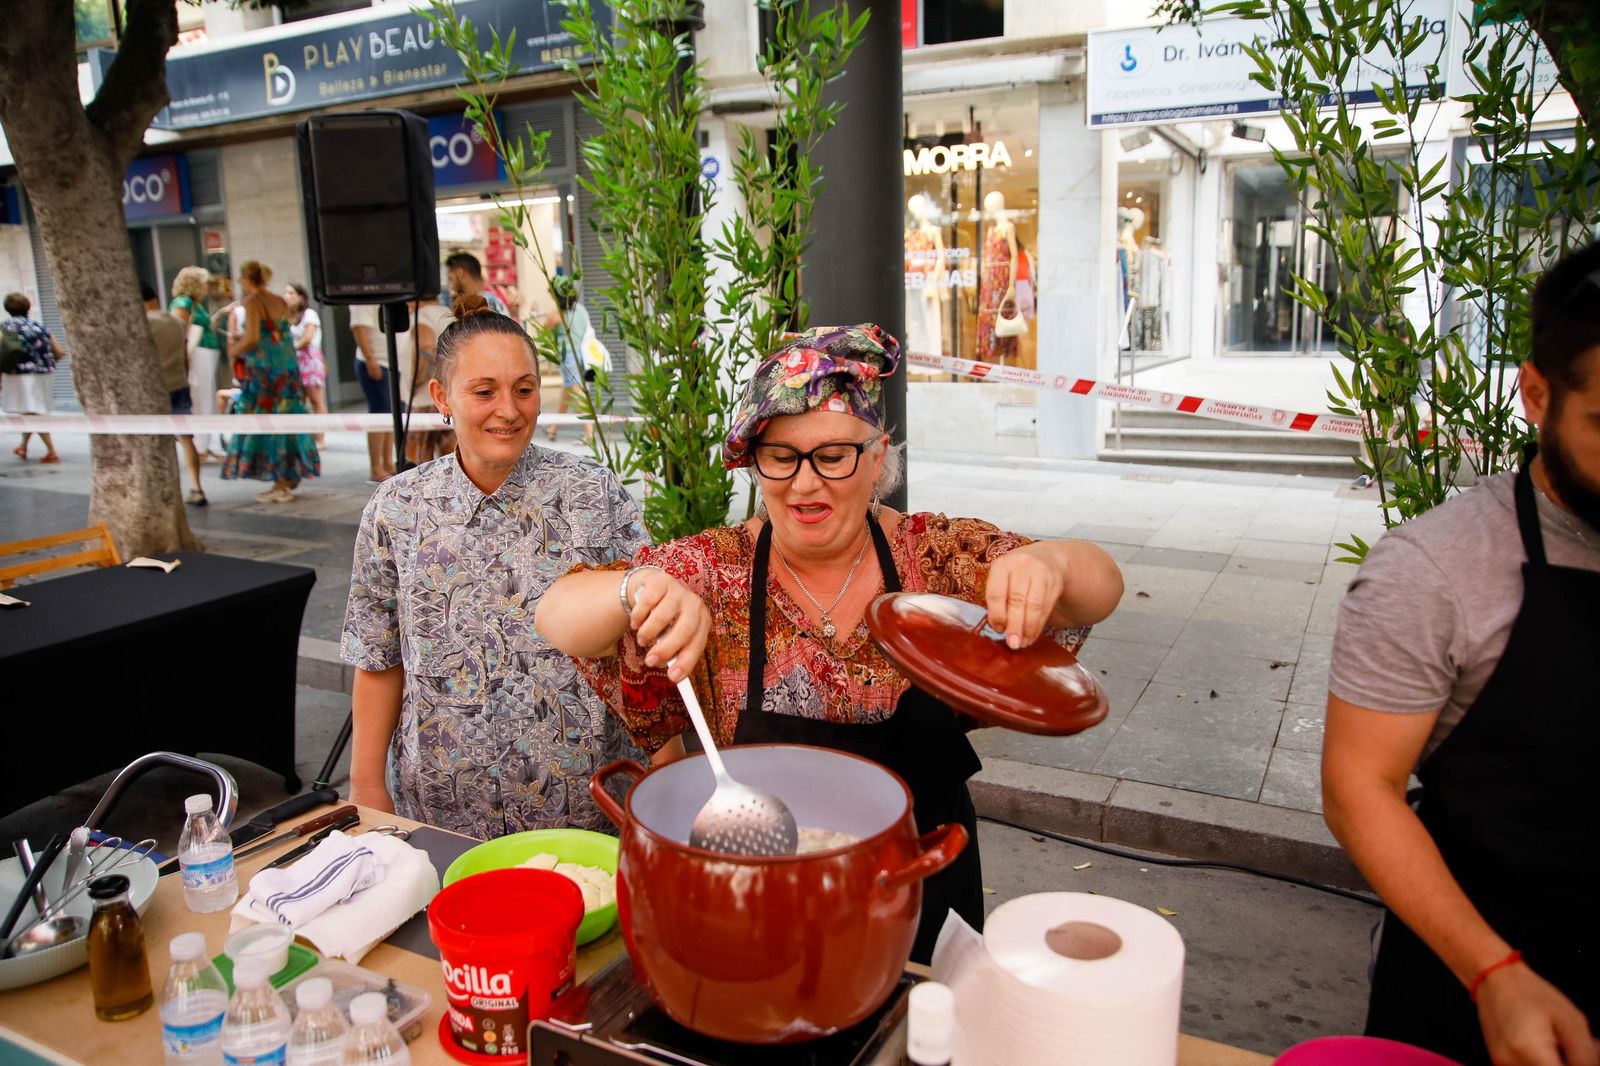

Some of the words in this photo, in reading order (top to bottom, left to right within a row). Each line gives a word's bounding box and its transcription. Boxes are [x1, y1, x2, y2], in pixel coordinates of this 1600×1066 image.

[303, 34, 363, 70] PLAY
[1163, 45, 1190, 63] Dr.
[1198, 37, 1243, 59] Iván
[382, 62, 448, 85] Bienestar
[903, 141, 1012, 177] MORRA
[1098, 389, 1153, 403] AYUNTAMIENTO
[1207, 406, 1264, 421] AYUNTAMIENTO
[441, 959, 511, 996] ocilla
